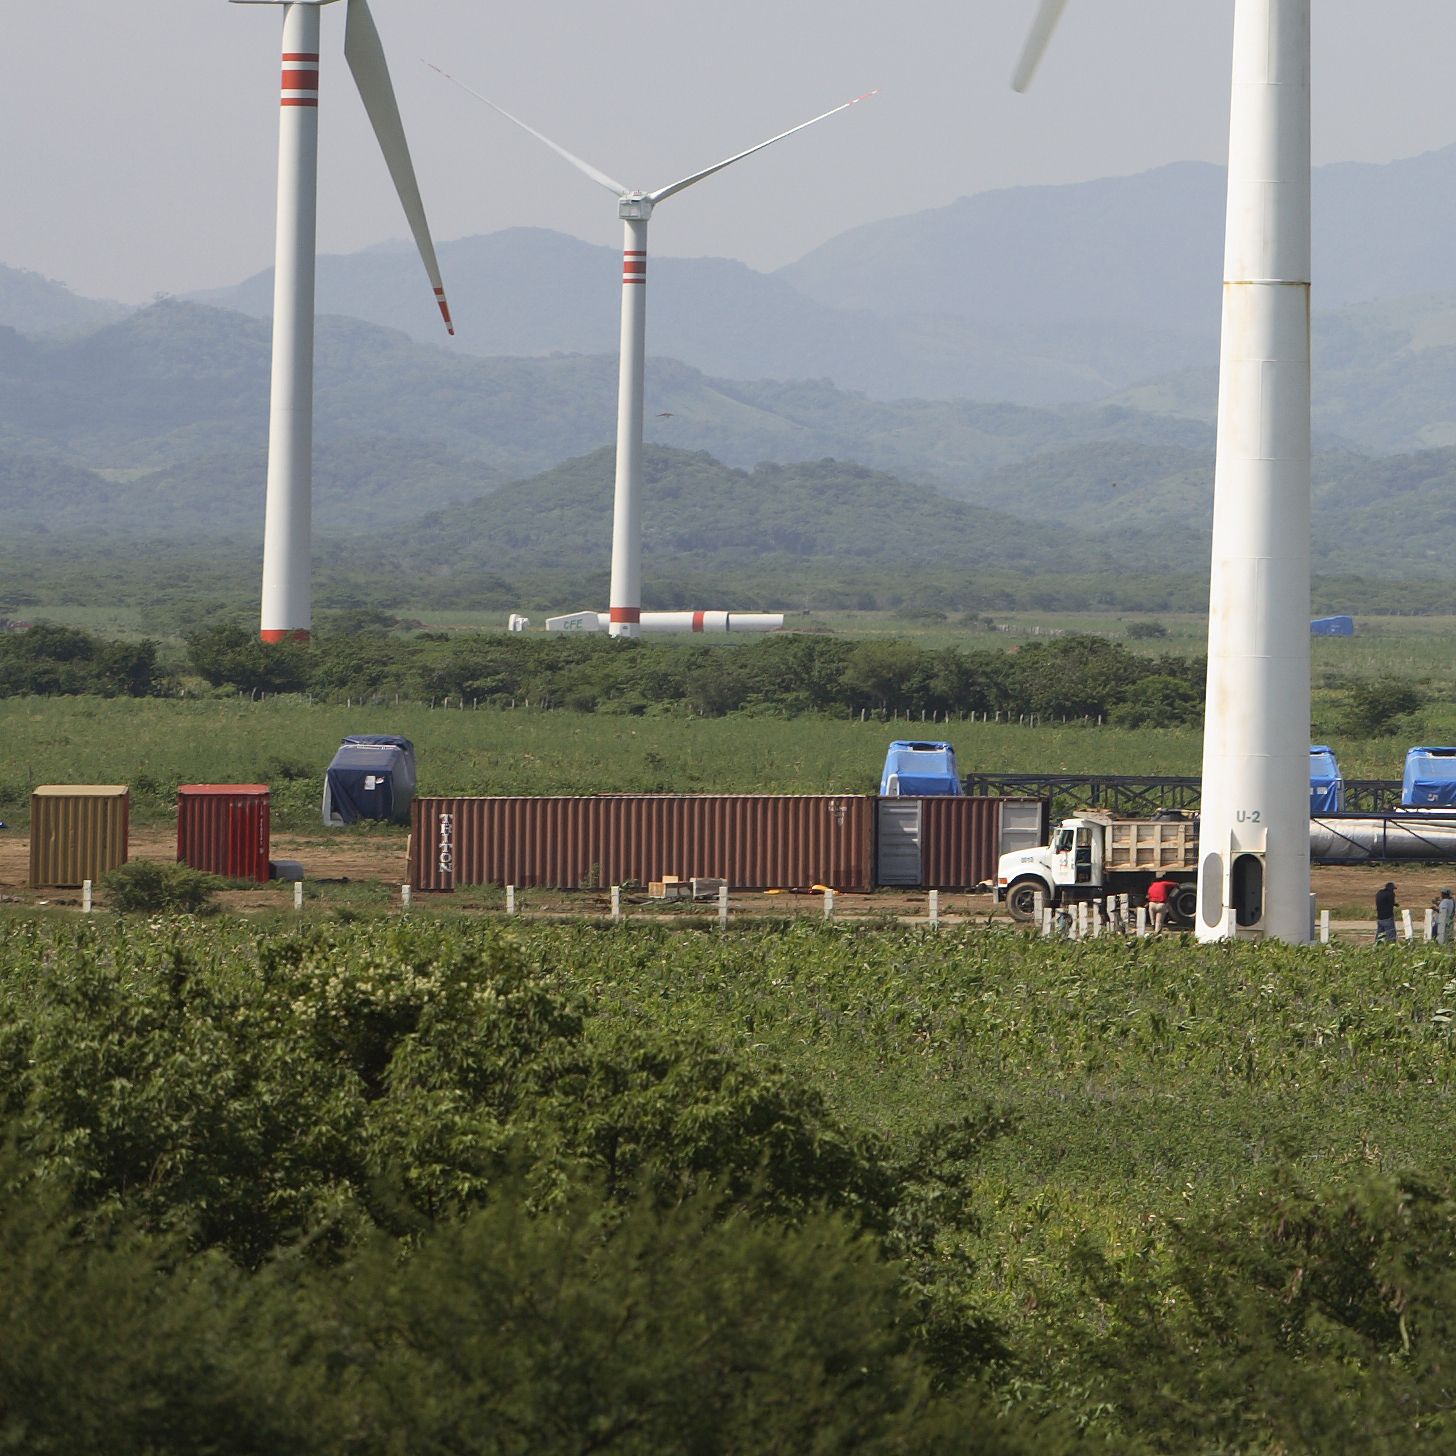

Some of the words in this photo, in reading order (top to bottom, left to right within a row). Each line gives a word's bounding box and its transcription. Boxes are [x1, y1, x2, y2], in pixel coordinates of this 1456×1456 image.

[563, 618, 583, 630] CFE
[1236, 810, 1261, 823] U-2
[439, 813, 453, 873] TRITON
